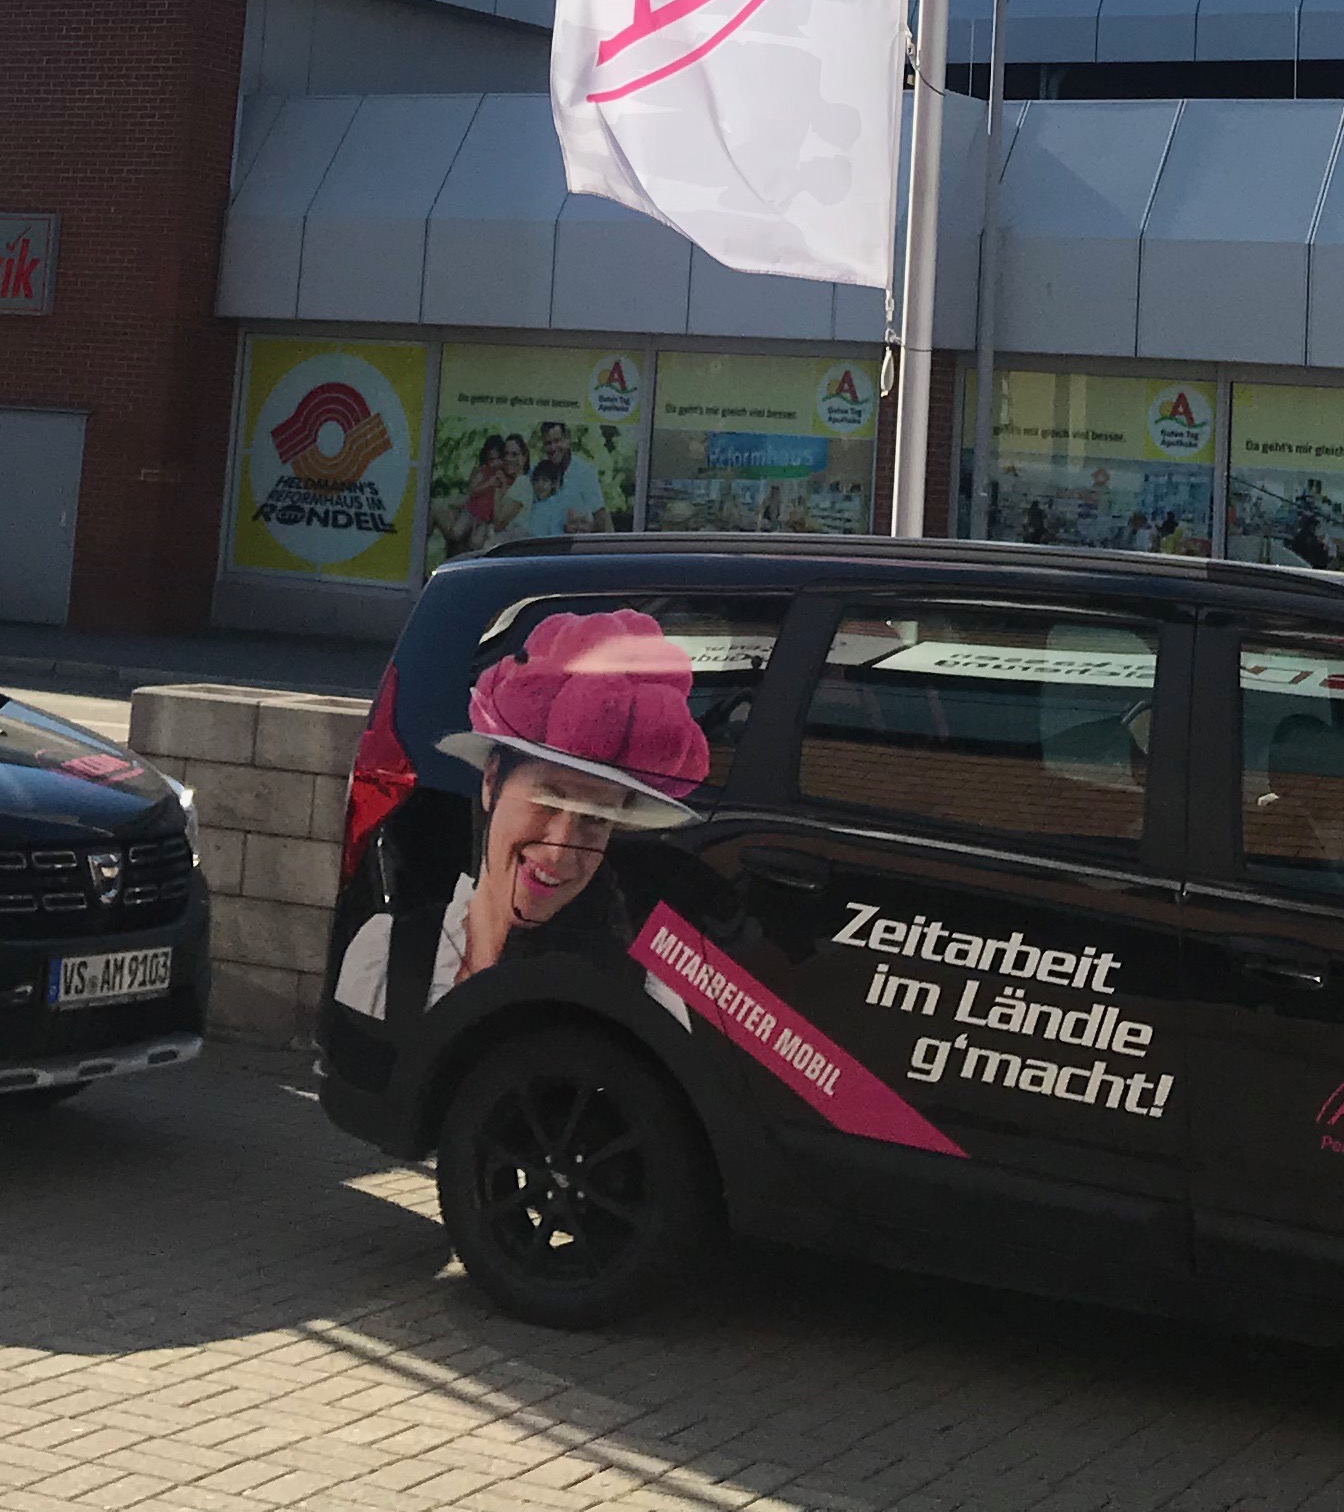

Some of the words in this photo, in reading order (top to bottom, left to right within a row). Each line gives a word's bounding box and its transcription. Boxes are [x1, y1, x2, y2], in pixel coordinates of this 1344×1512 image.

[1245, 438, 1260, 451] Da
[1262, 442, 1293, 455] geht's
[1295, 443, 1313, 454] mir
[63, 960, 88, 996] VS
[100, 956, 126, 993] AM
[830, 901, 1122, 995] Zeitarbeit
[649, 925, 776, 1044] MITARBEITER
[773, 1028, 845, 1097] MOBIL
[864, 963, 941, 1016] im
[955, 978, 1154, 1058] Ländle
